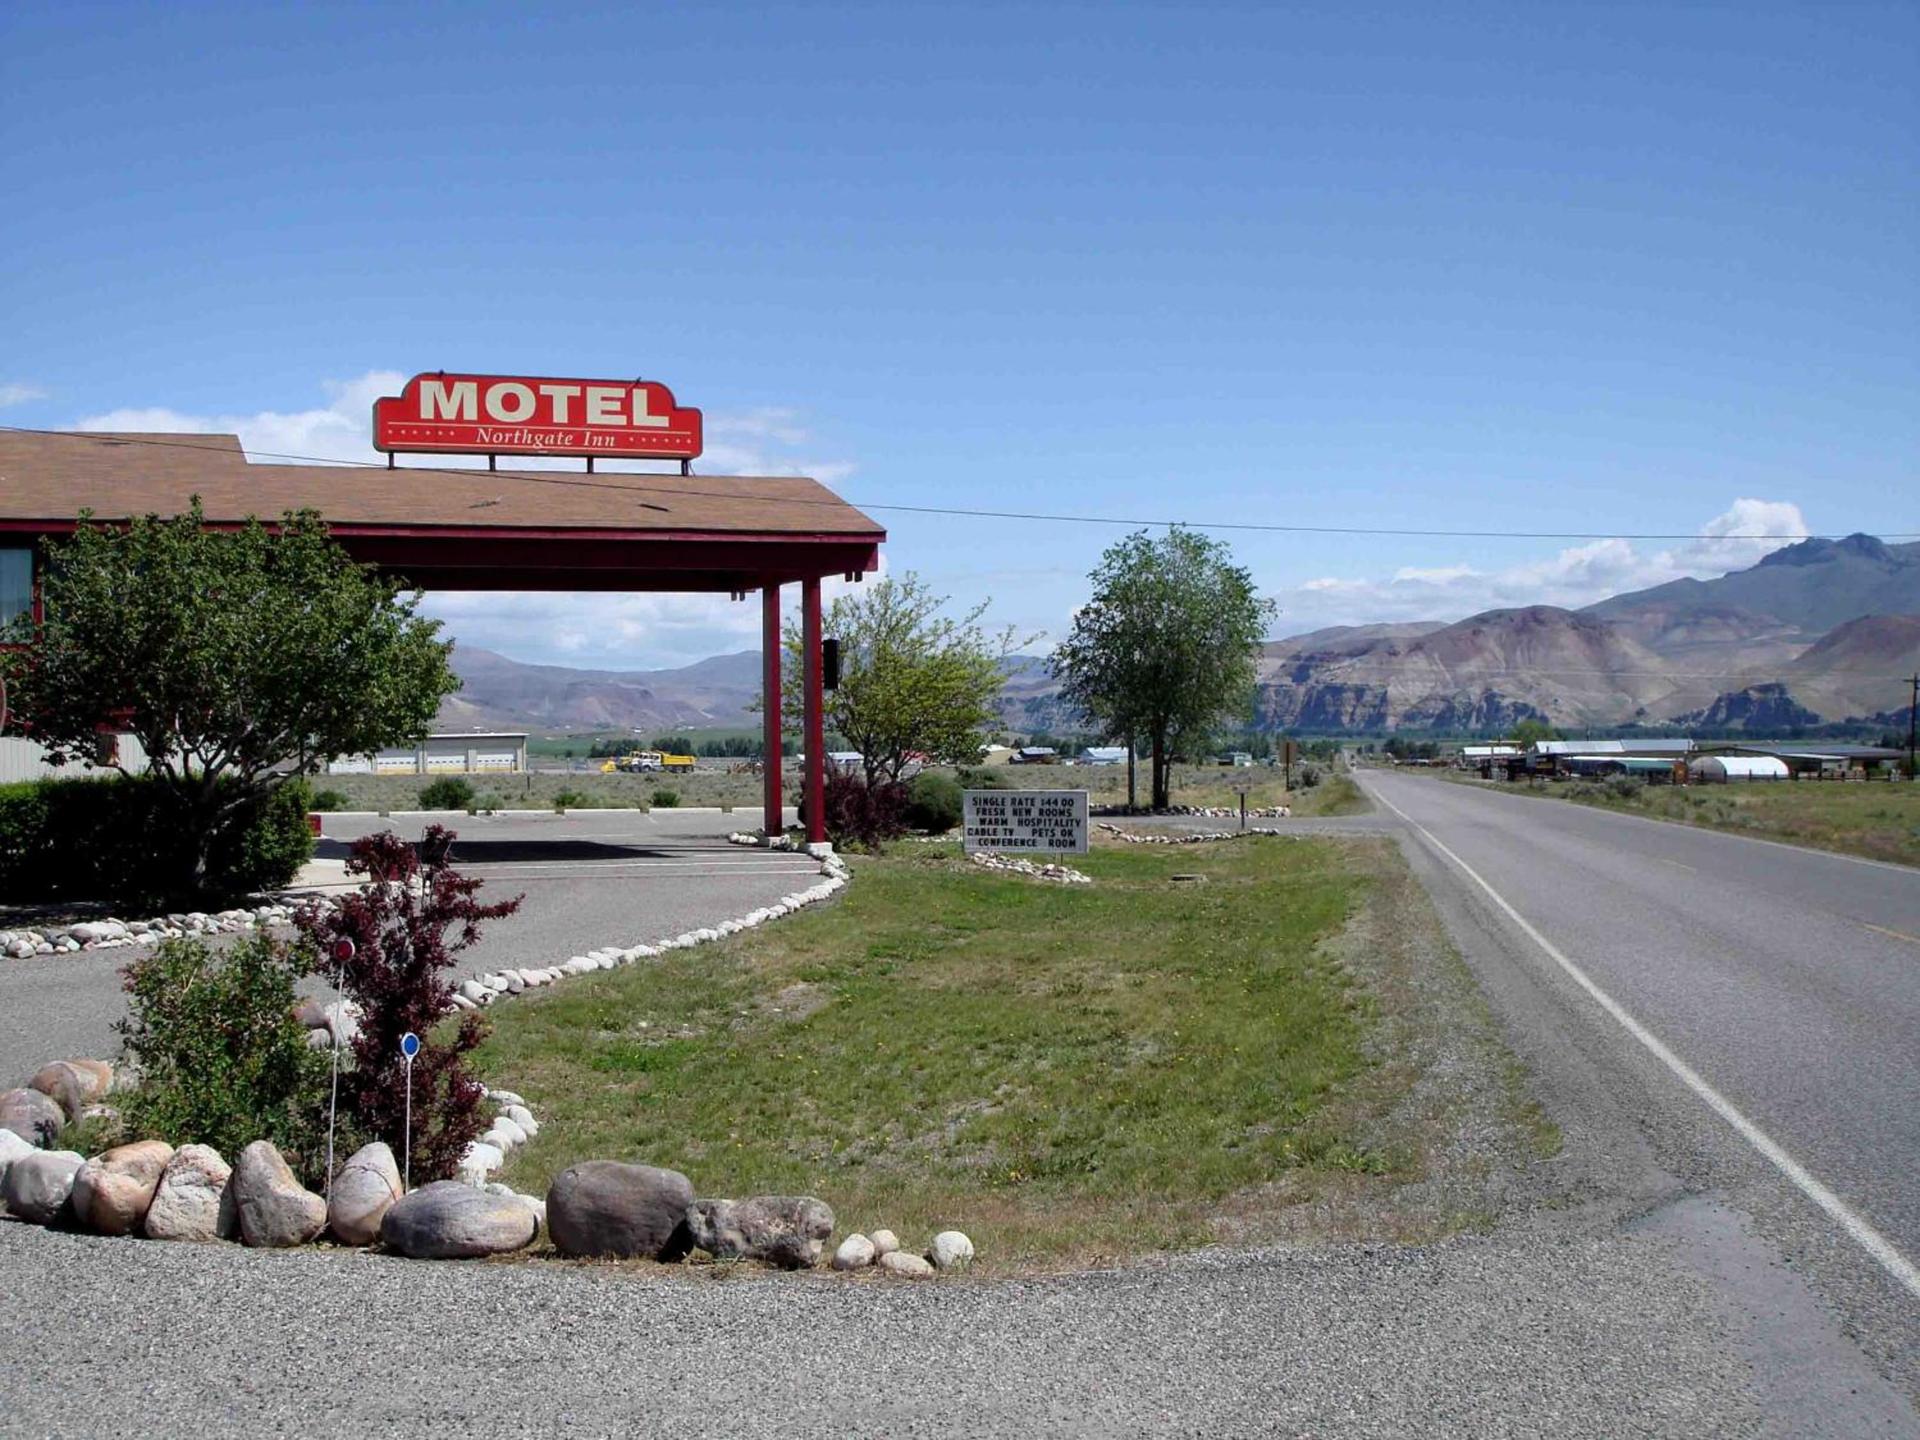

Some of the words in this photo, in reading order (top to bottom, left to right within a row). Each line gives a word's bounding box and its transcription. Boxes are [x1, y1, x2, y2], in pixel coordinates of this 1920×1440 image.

[419, 380, 670, 428] MOTEL
[476, 428, 574, 448] Northgate
[583, 431, 616, 447] Inn
[972, 797, 1006, 807] SINGLE
[1010, 797, 1036, 807] RATE
[976, 807, 1006, 816] FRESH
[1012, 807, 1032, 817] NEW
[1039, 808, 1073, 817] ROOMS
[979, 818, 1008, 826] WARM
[1017, 818, 1081, 827] HOSPITALITY
[967, 827, 998, 836] CABLE
[1003, 828, 1014, 836] TV
[1031, 828, 1055, 837] PETS
[1061, 828, 1074, 837] OK
[978, 838, 1037, 847] CONFERENCE
[1048, 839, 1077, 848] ROOM
